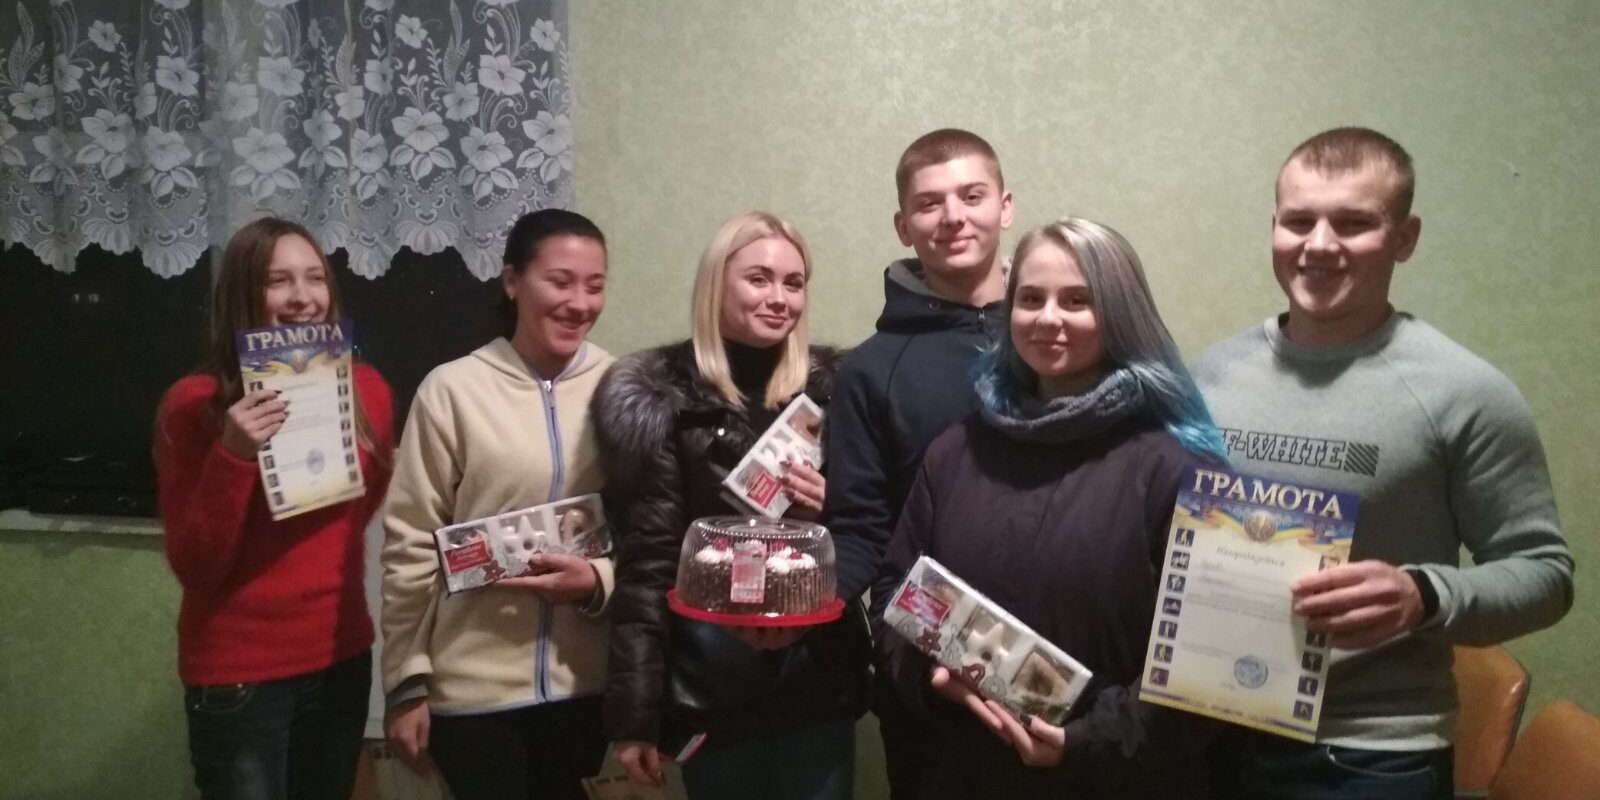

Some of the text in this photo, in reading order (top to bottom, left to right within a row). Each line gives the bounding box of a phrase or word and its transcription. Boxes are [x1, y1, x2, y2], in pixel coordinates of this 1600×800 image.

[245, 322, 344, 352] ГРАМОТА
[1216, 427, 1347, 471] F-WHITE
[1193, 468, 1343, 521] ГРАМОТА
